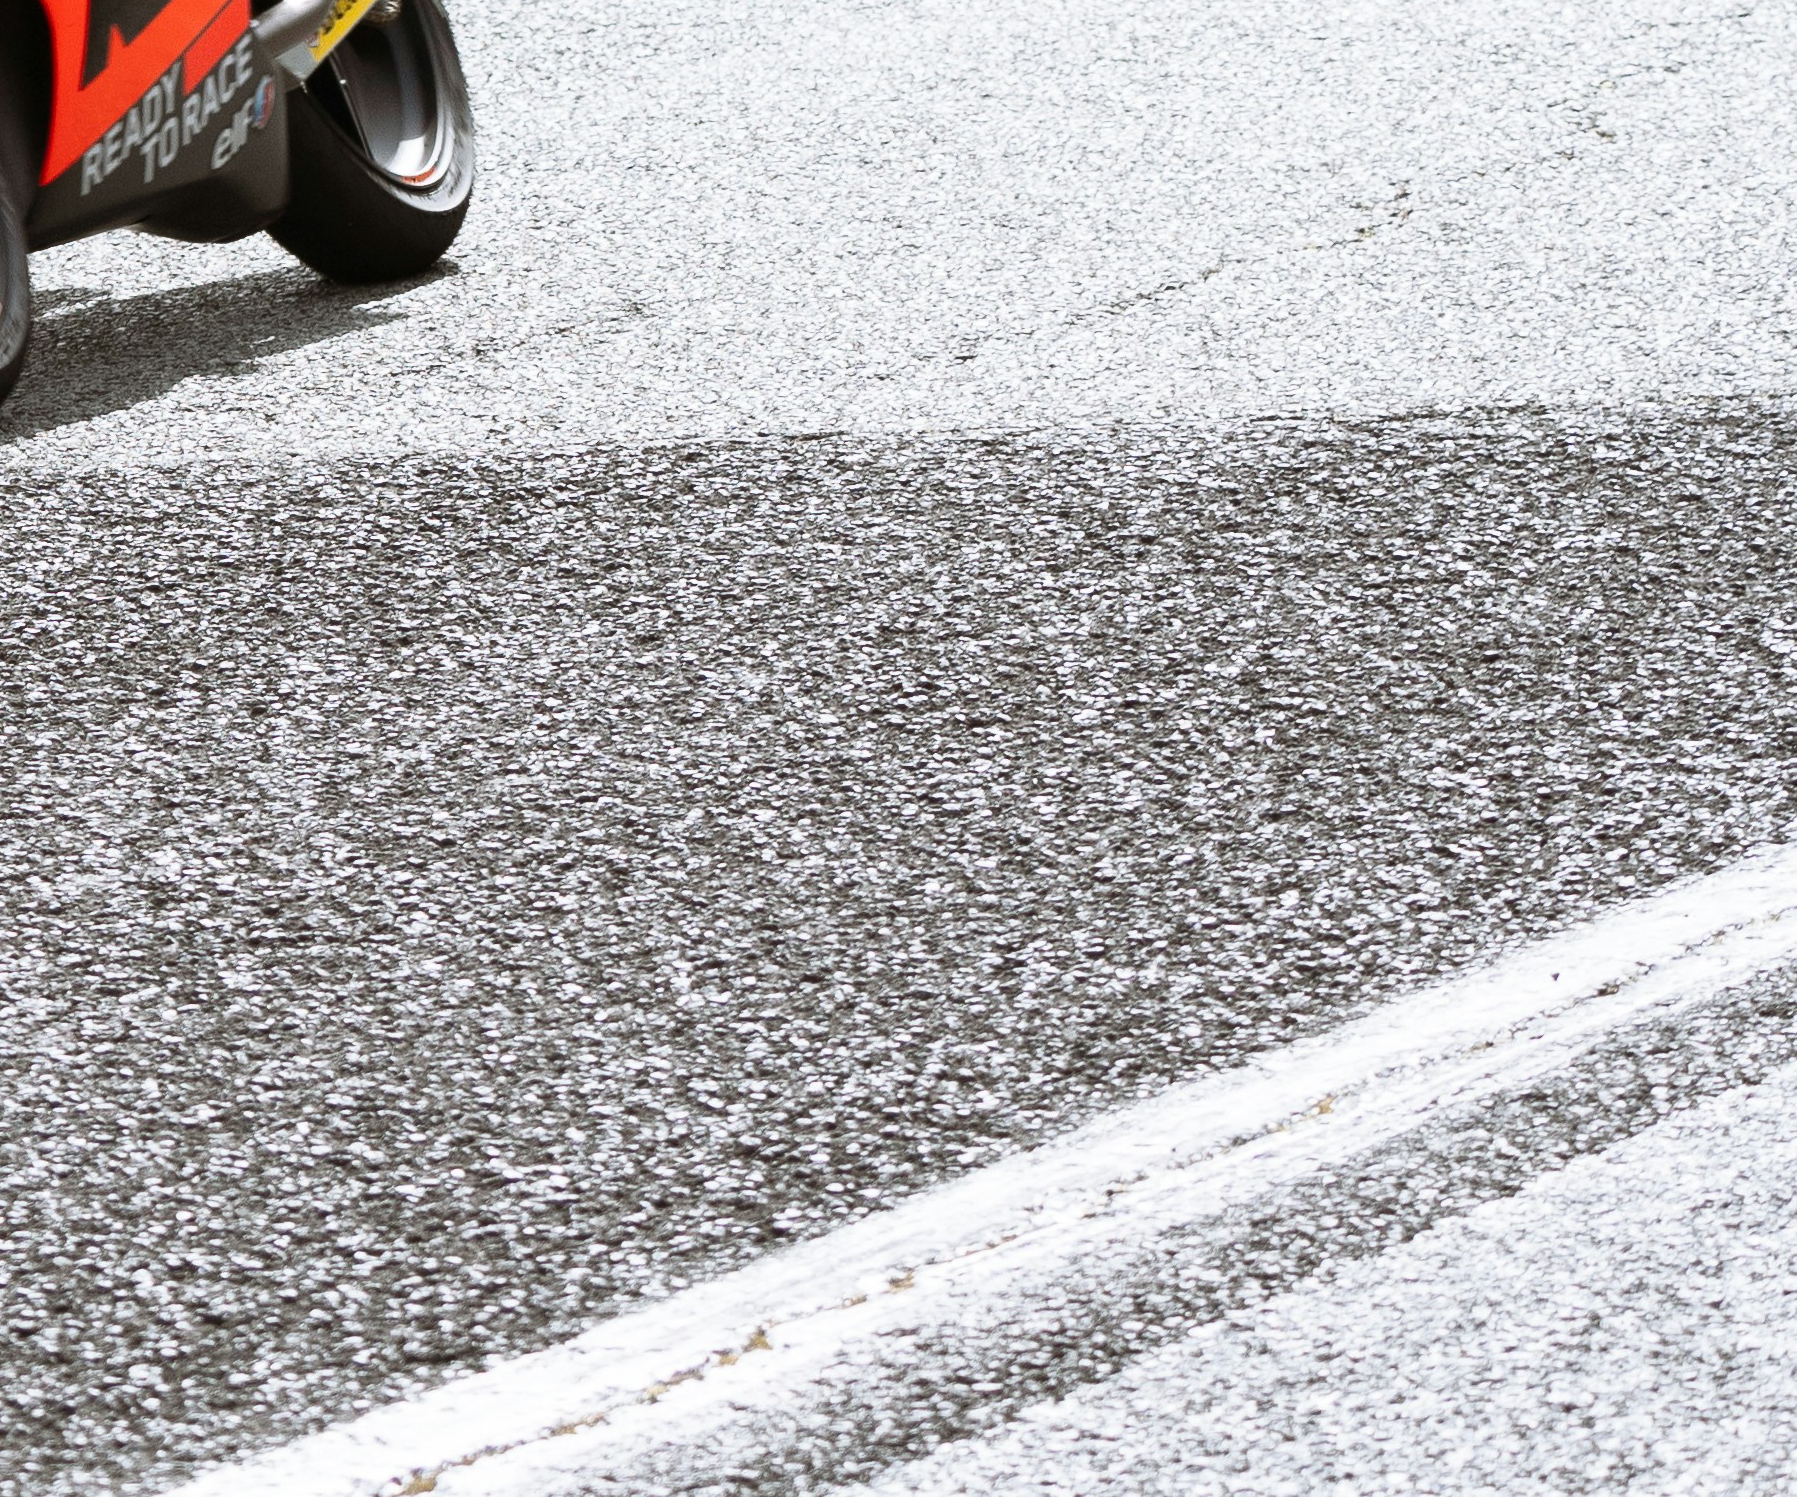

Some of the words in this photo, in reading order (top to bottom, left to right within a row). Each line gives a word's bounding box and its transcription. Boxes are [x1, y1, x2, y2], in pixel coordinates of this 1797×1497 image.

[80, 60, 183, 197] READY
[140, 116, 190, 184] TO
[182, 33, 254, 147] RACE
[210, 96, 256, 170] elf
